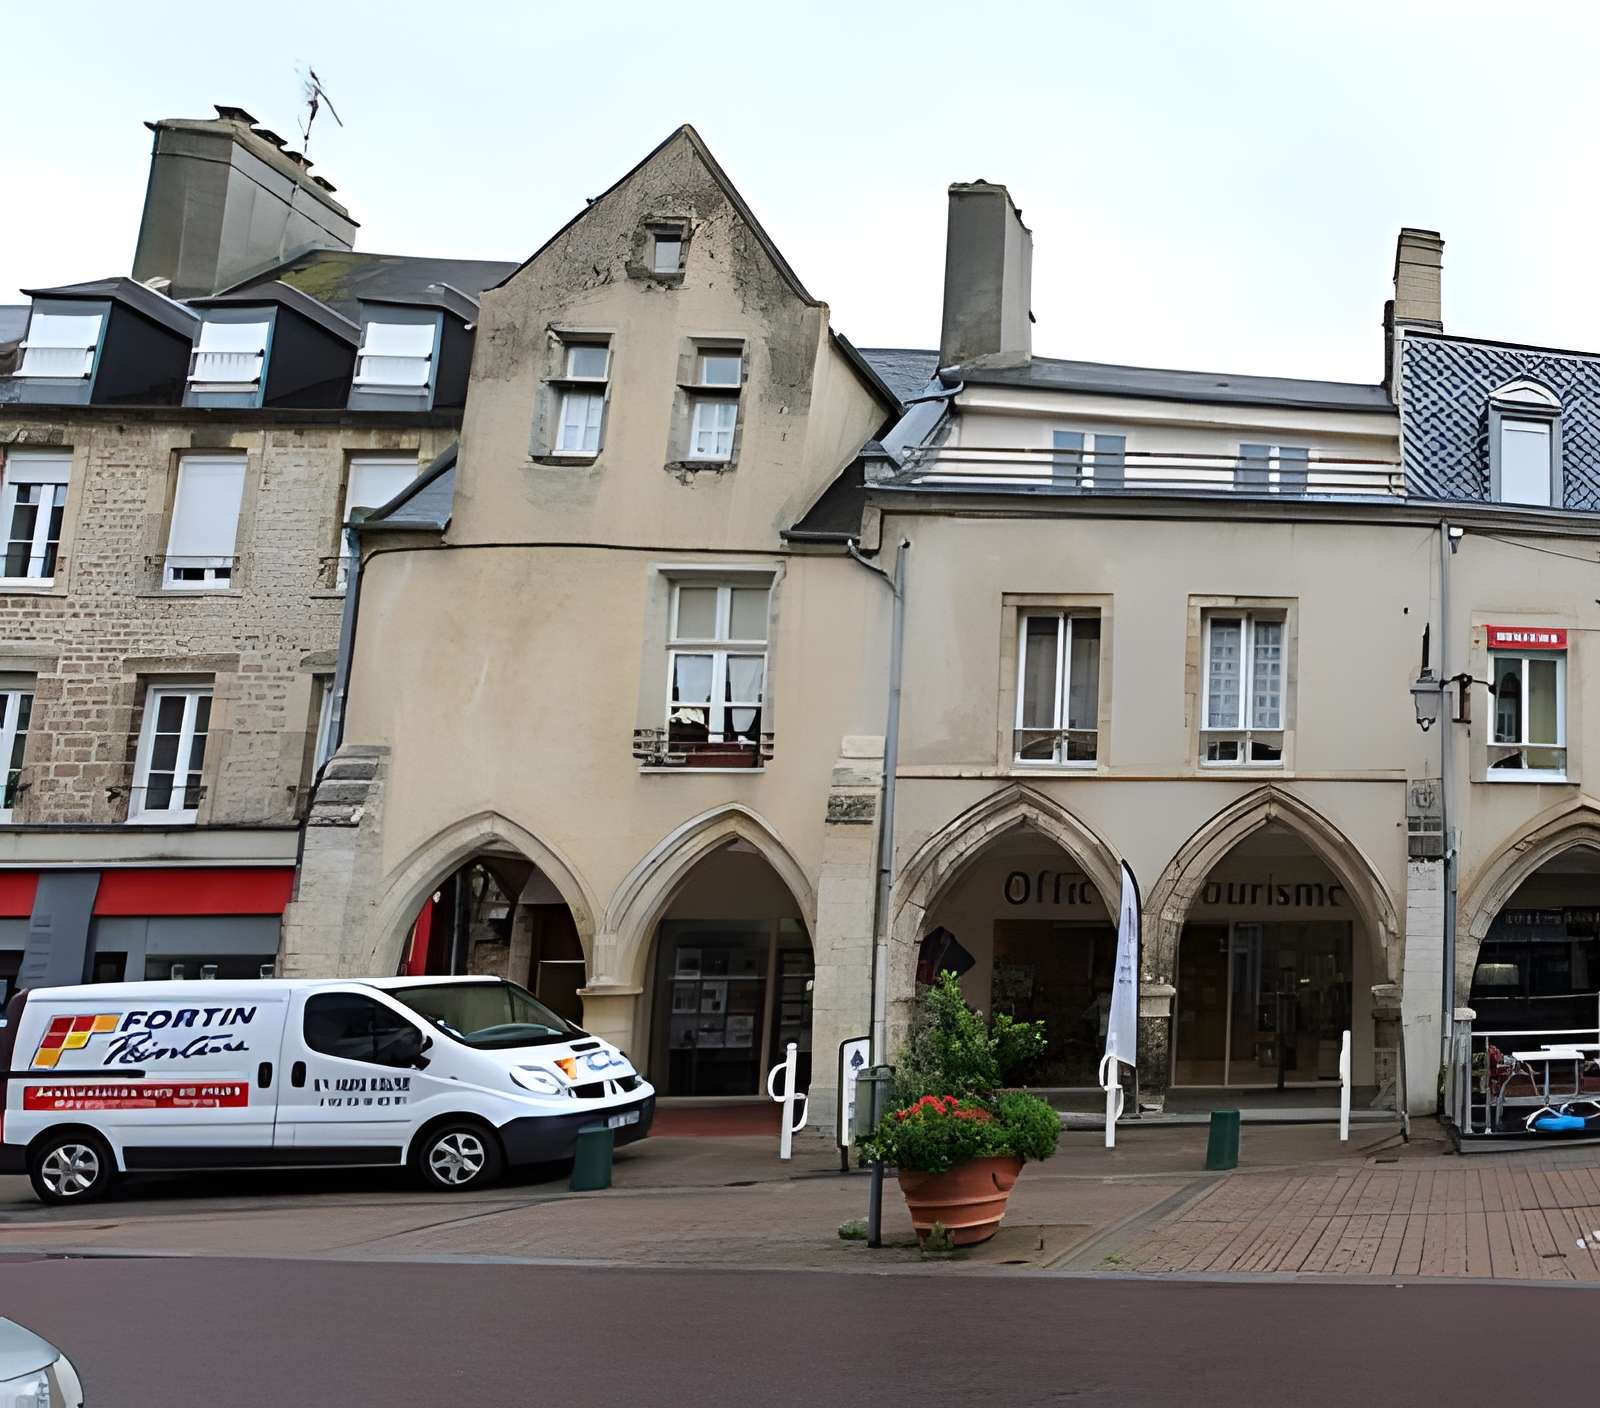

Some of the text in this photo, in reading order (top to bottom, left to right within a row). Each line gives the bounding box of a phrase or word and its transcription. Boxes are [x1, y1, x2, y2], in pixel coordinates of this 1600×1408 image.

[1003, 870, 1345, 907] Offic ourisme
[120, 1006, 257, 1032] FORTIN
